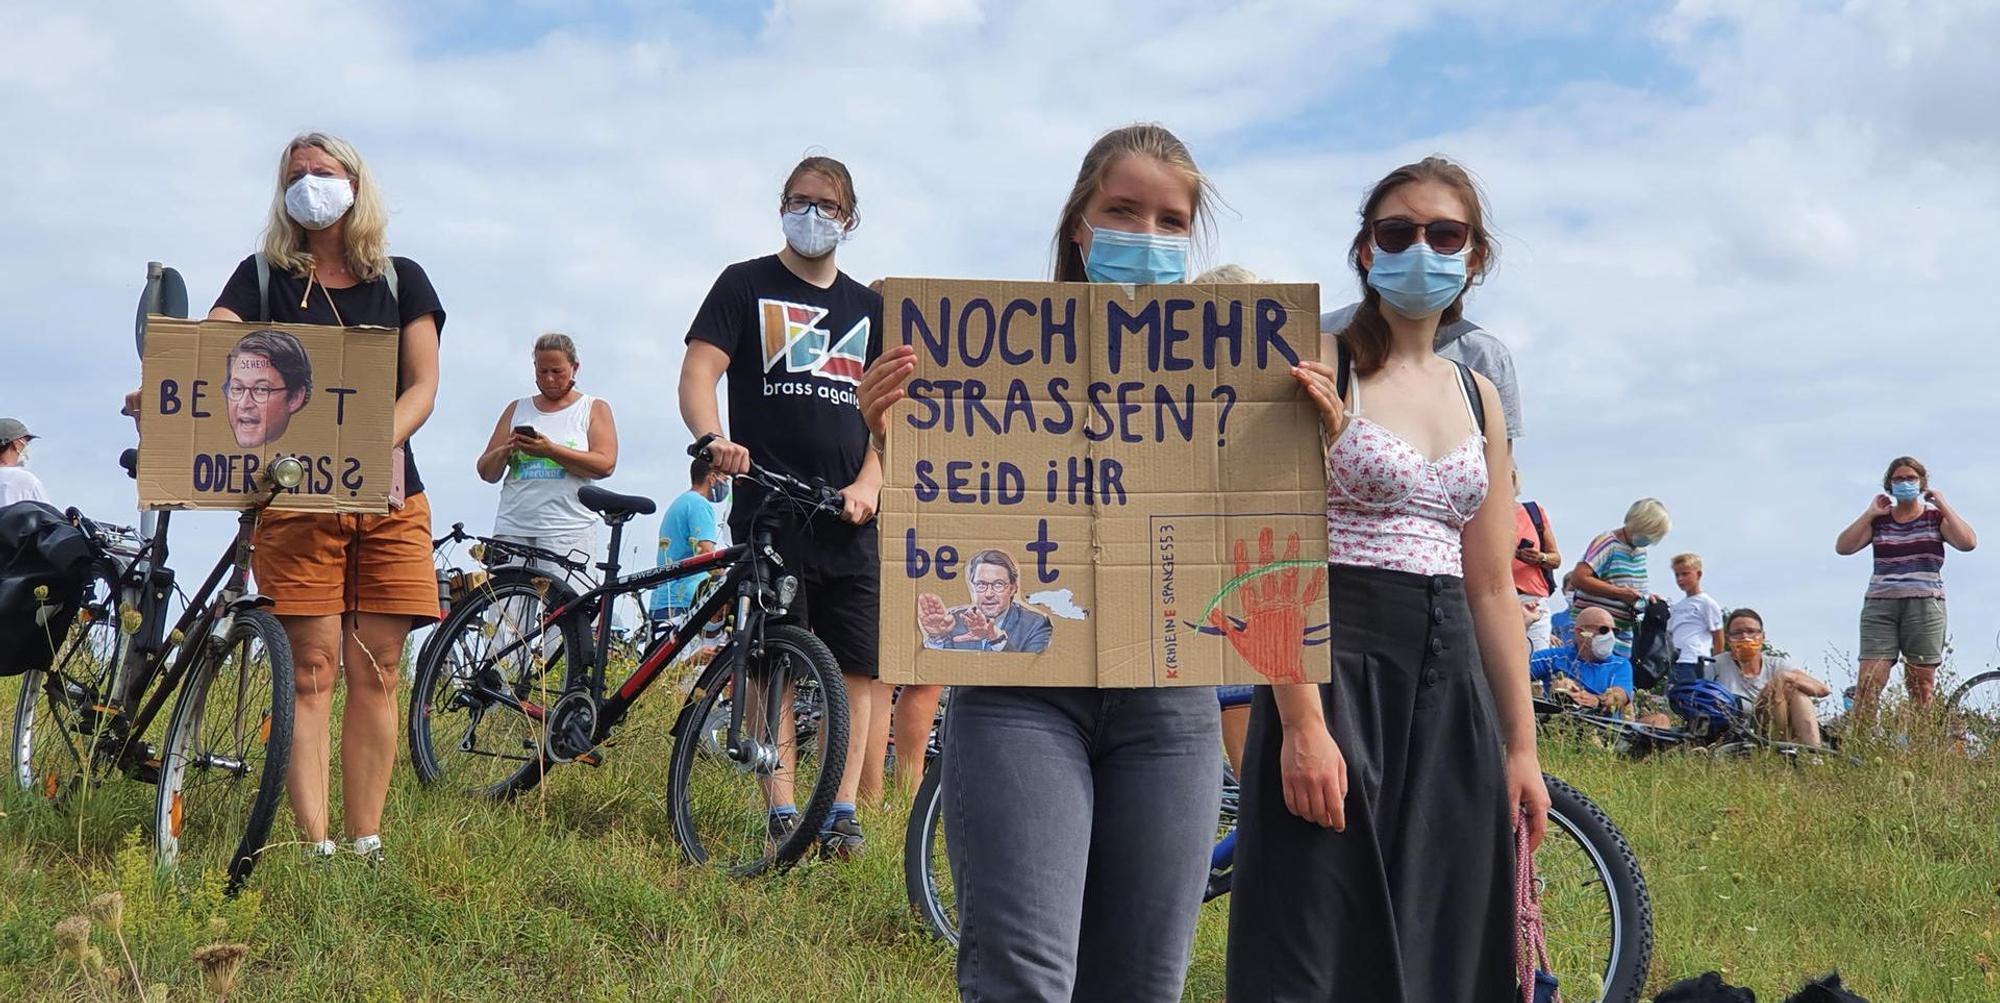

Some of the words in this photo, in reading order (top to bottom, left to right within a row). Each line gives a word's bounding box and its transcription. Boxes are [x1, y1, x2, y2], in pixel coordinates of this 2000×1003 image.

[901, 296, 1076, 368] NOCH
[1107, 298, 1299, 374] MEHR
[160, 379, 211, 418] BE
[325, 386, 357, 425] T
[763, 378, 812, 396] brass
[907, 378, 1237, 447] STRASSEN?
[194, 453, 260, 494] ODER
[906, 528, 959, 580] be
[1026, 519, 1060, 583] t
[1164, 609, 1179, 679] K(RH)EINE
